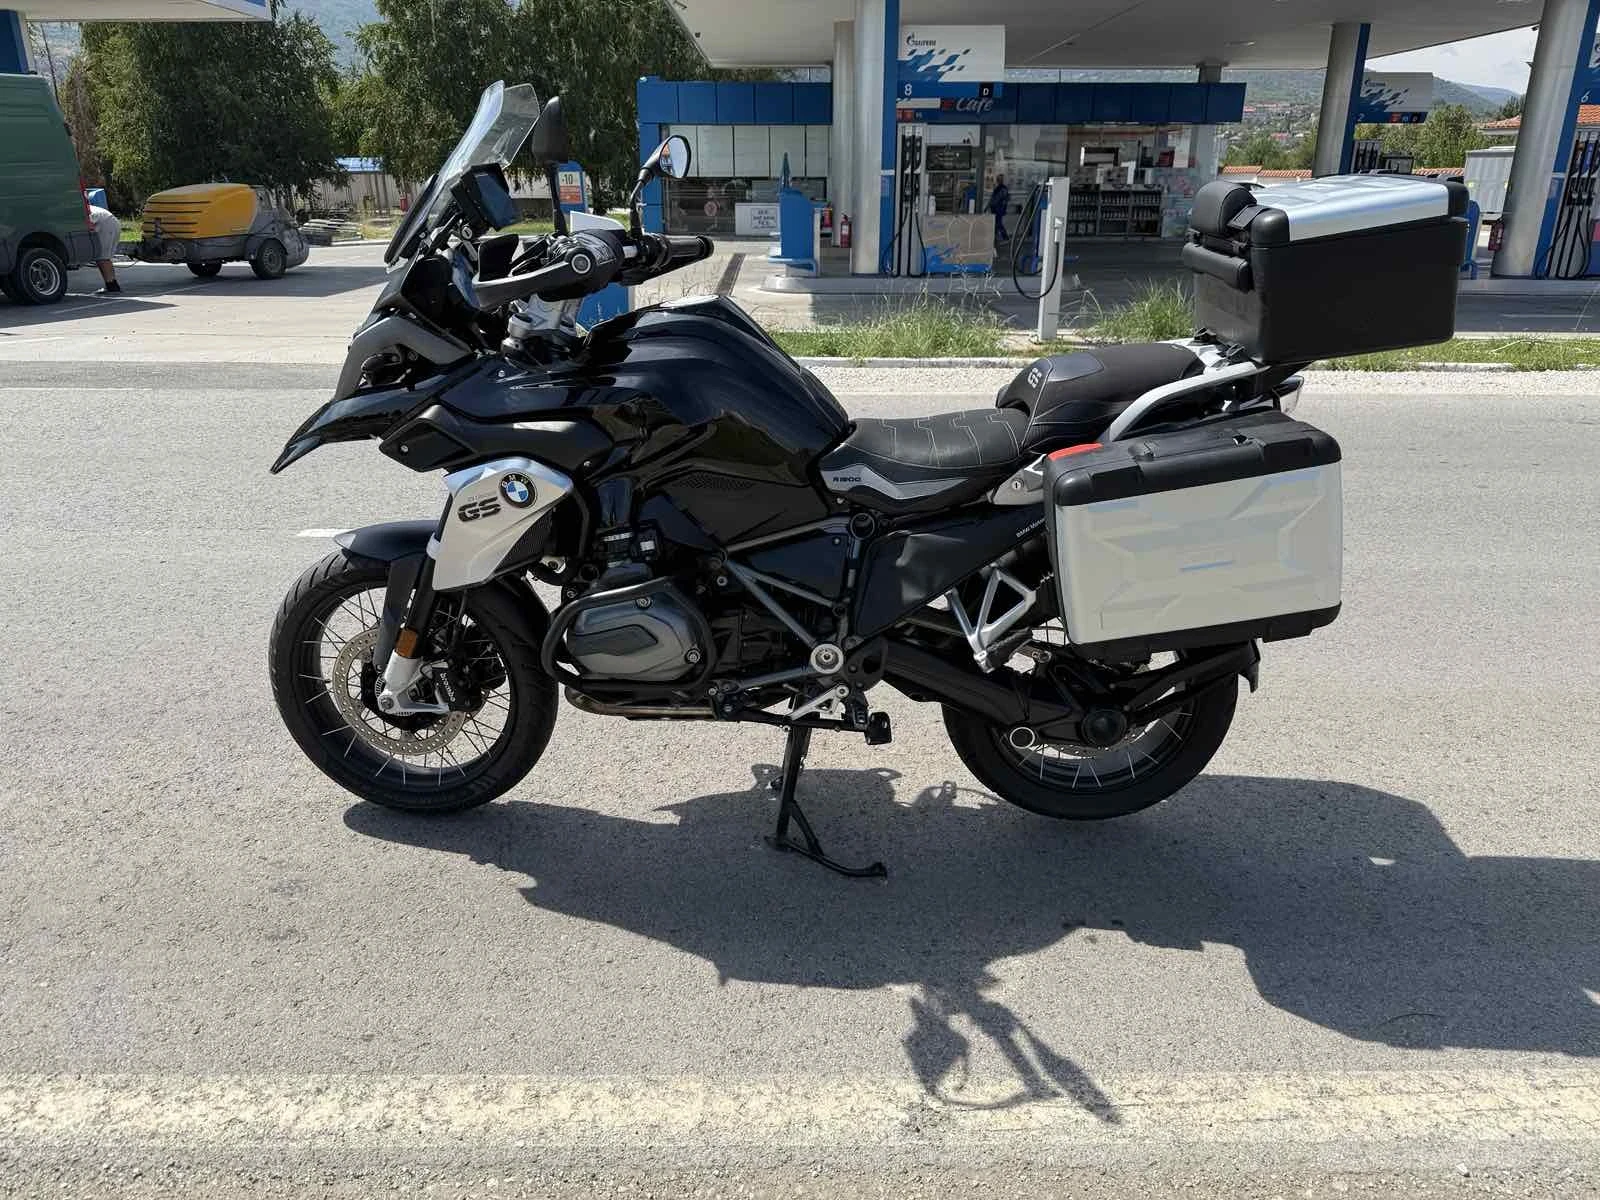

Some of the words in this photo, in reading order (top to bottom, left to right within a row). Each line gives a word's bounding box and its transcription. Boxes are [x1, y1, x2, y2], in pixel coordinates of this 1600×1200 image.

[904, 83, 912, 96] 8
[982, 87, 990, 96] D
[1581, 90, 1591, 103] 6
[457, 495, 502, 522] GS
[439, 672, 456, 702] brembo
